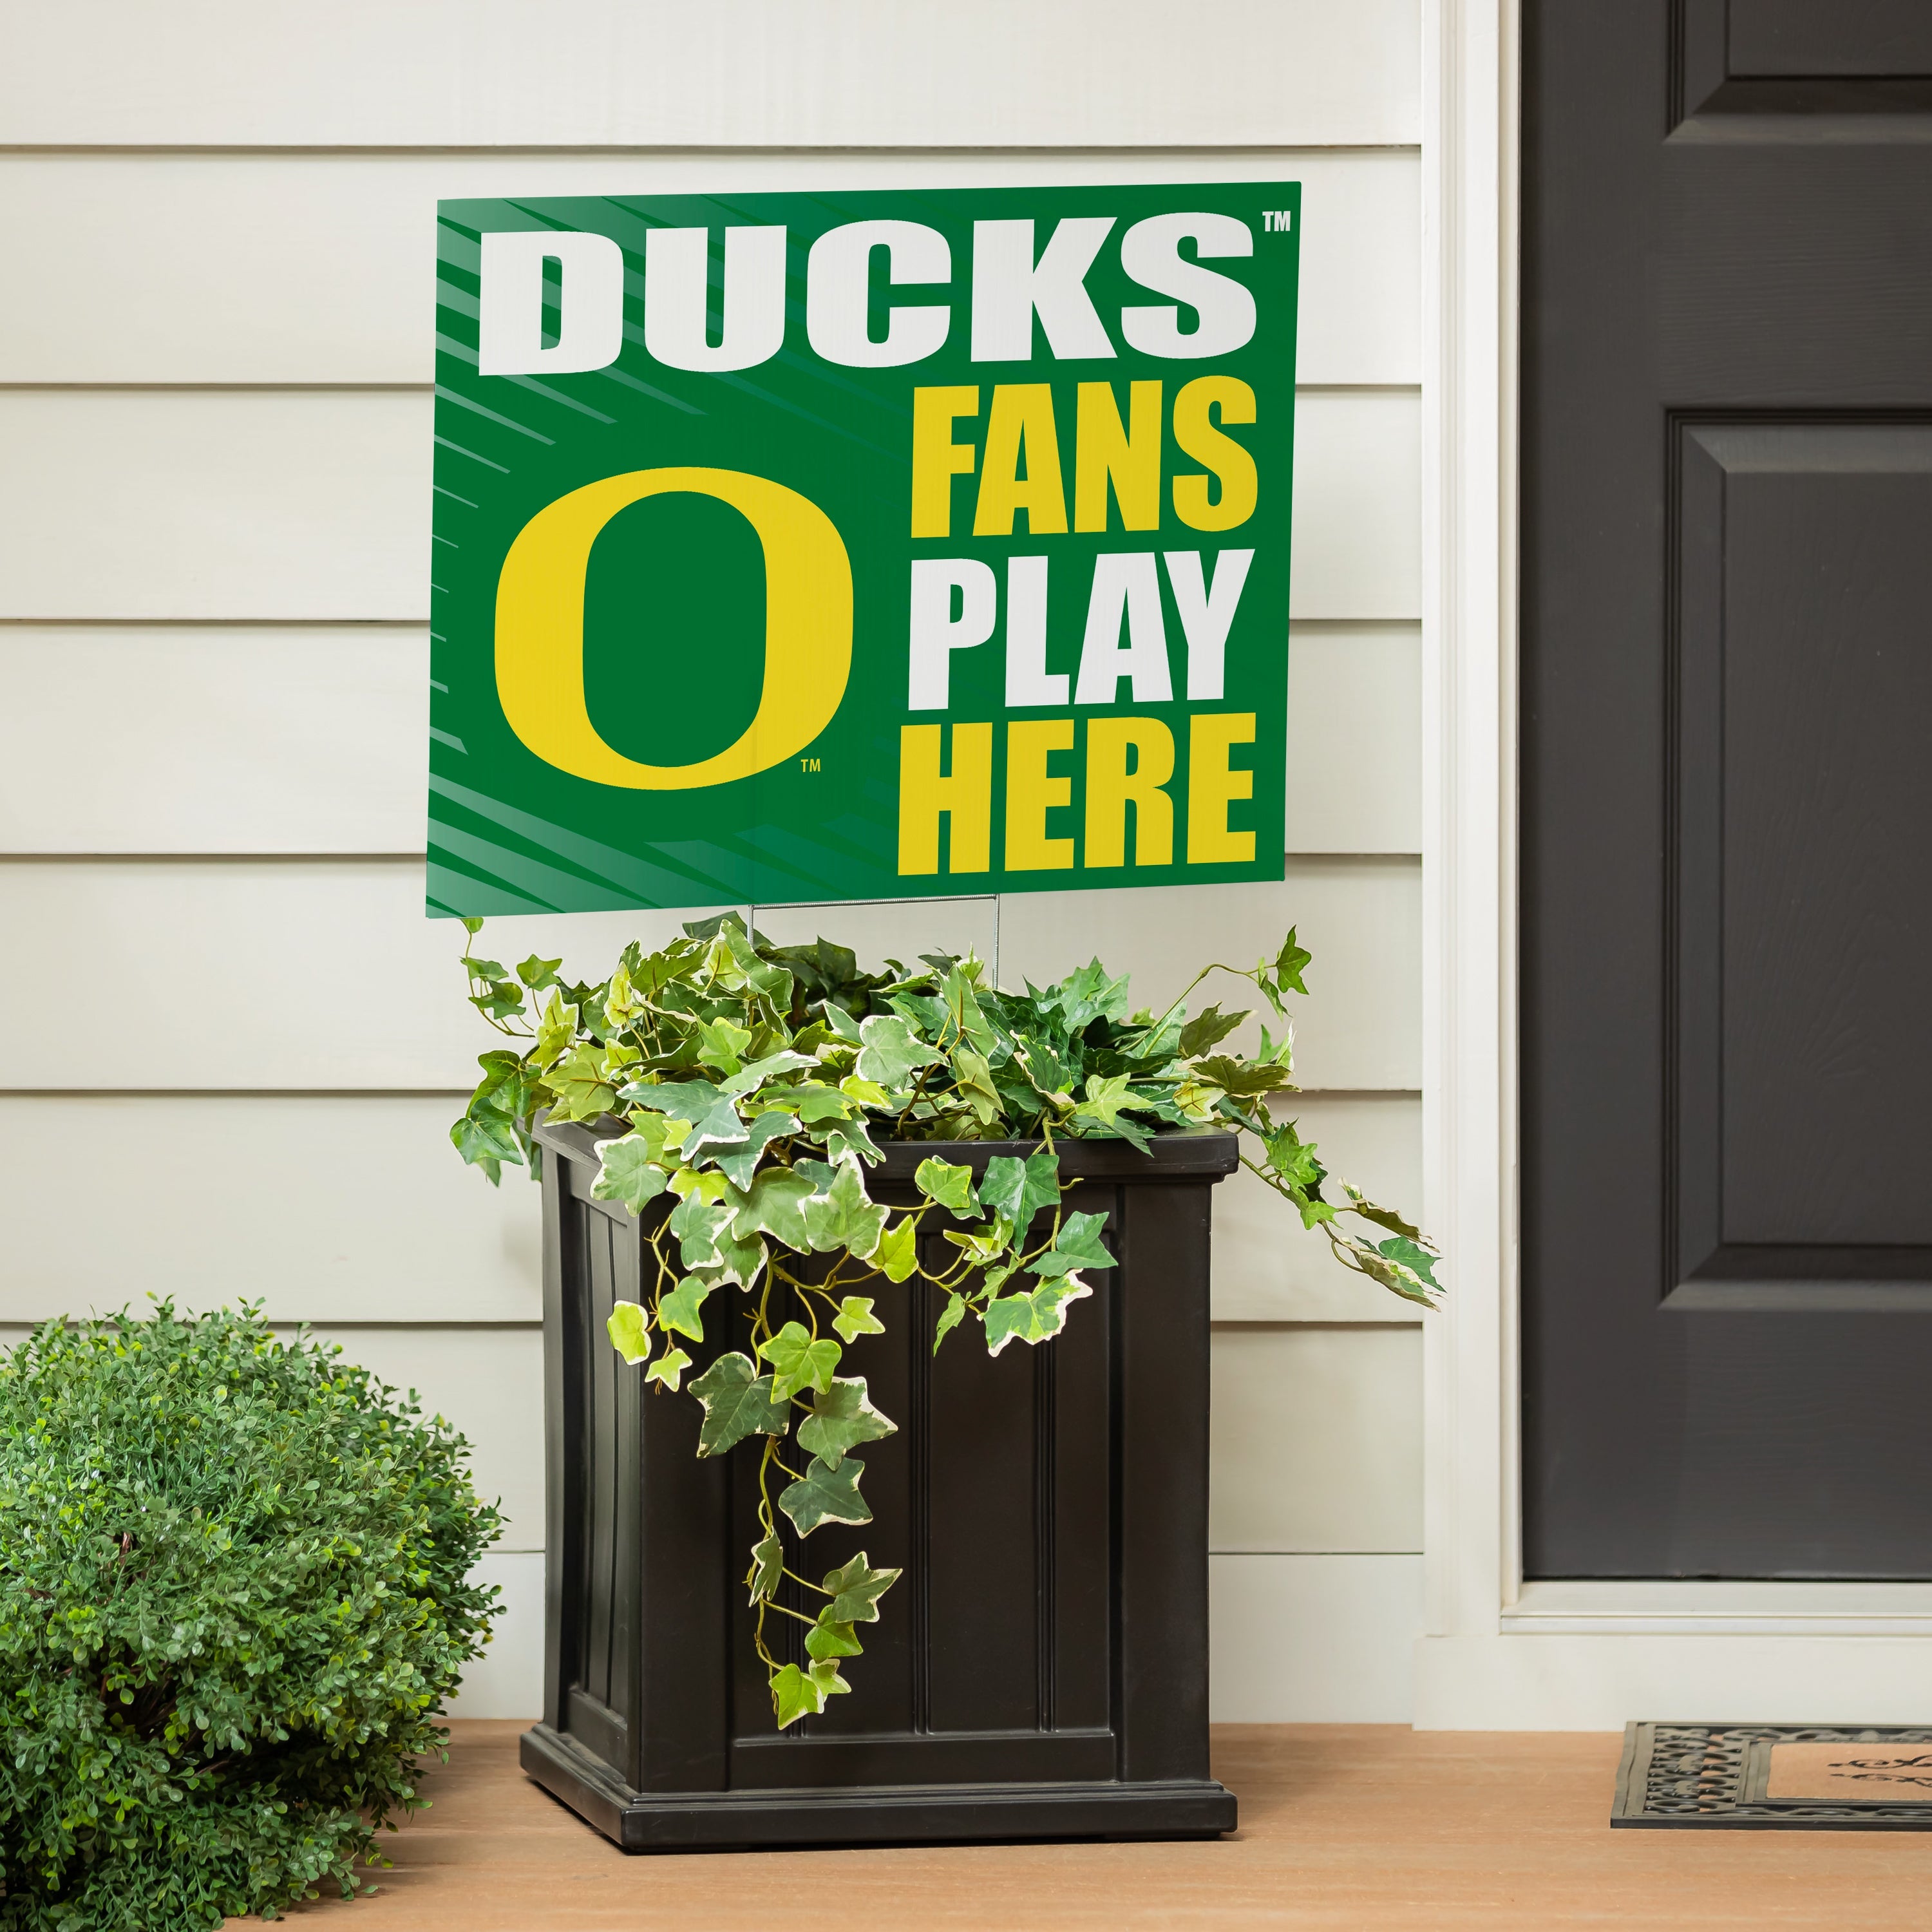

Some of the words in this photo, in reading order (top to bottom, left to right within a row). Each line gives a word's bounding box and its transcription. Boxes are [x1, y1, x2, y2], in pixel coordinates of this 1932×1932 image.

[479, 212, 1256, 375] DUCKS
[911, 375, 1258, 538] FANS
[495, 467, 853, 790] O
[908, 549, 1255, 711] PLAY
[898, 712, 1256, 876] HERE
